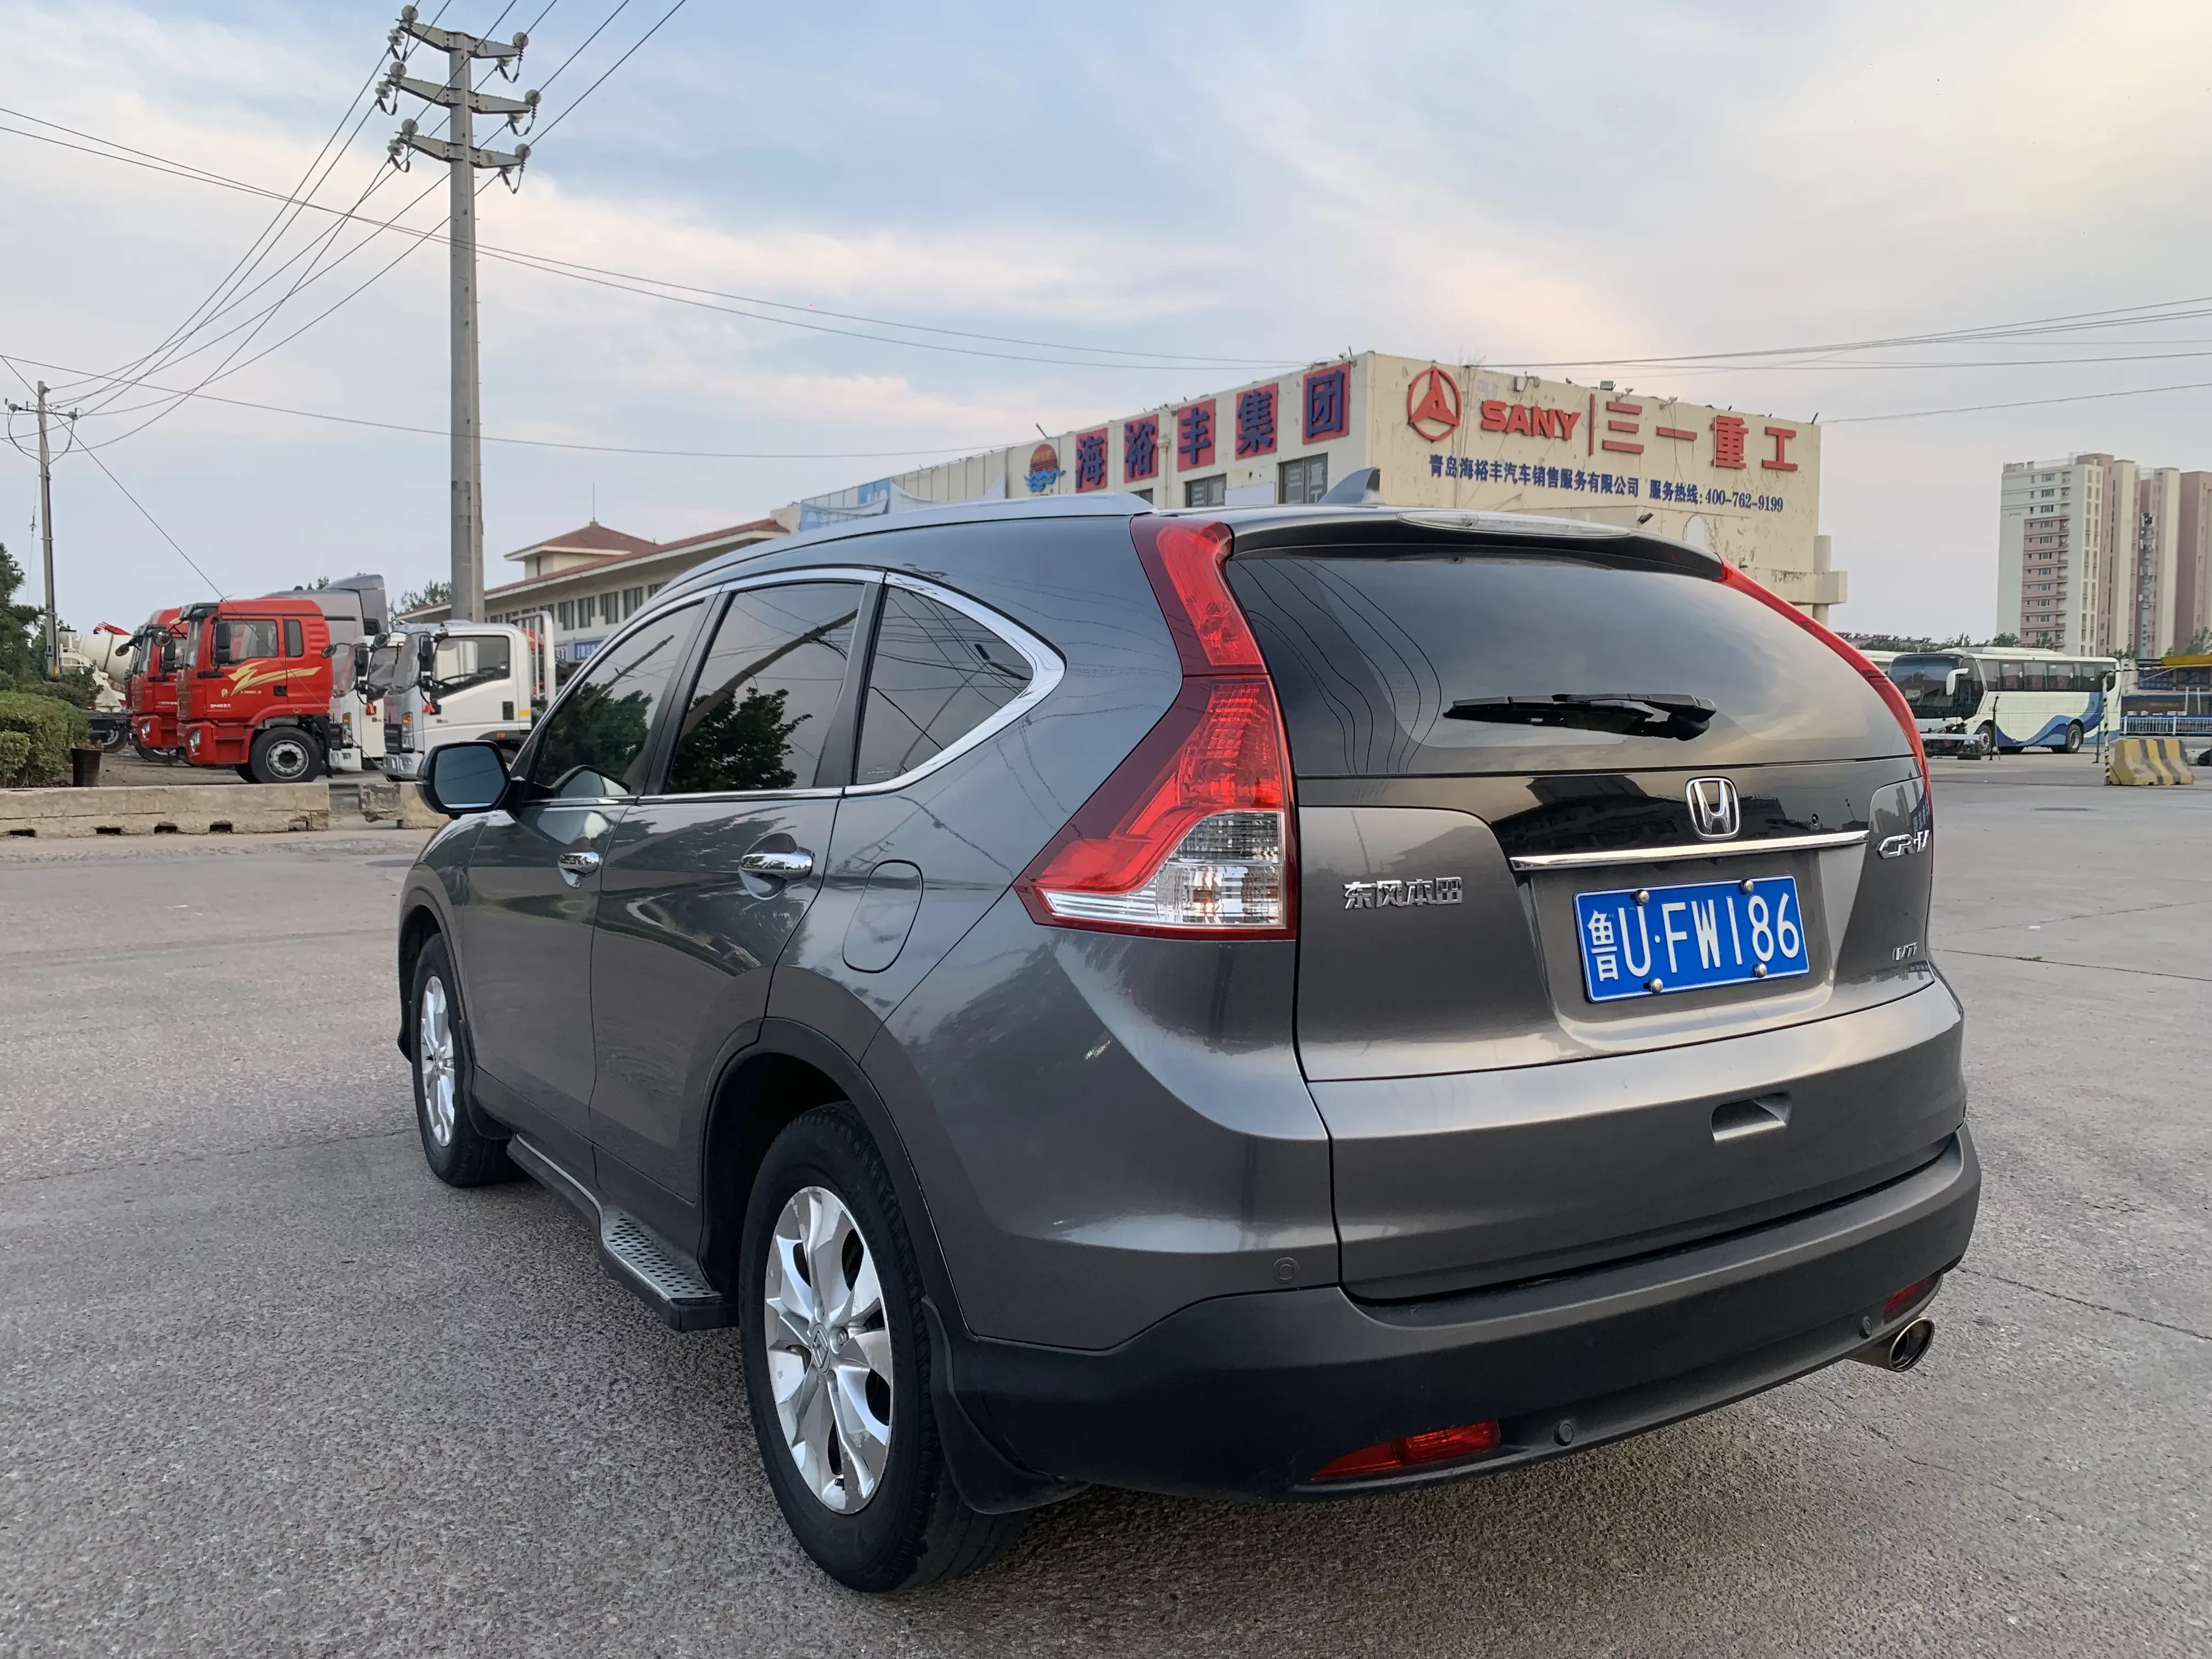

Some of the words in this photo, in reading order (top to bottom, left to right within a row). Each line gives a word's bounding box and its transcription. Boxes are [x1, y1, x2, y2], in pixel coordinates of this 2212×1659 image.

[1076, 370, 1345, 488] 海裕丰集团
[1481, 399, 1581, 440] SANY
[1602, 400, 1798, 471] 三一重工
[1429, 454, 1639, 498] 青岛海裕丰汽车销售服务有限公司
[1877, 830, 1929, 859] CR-V
[1344, 876, 1463, 910] 东风本田
